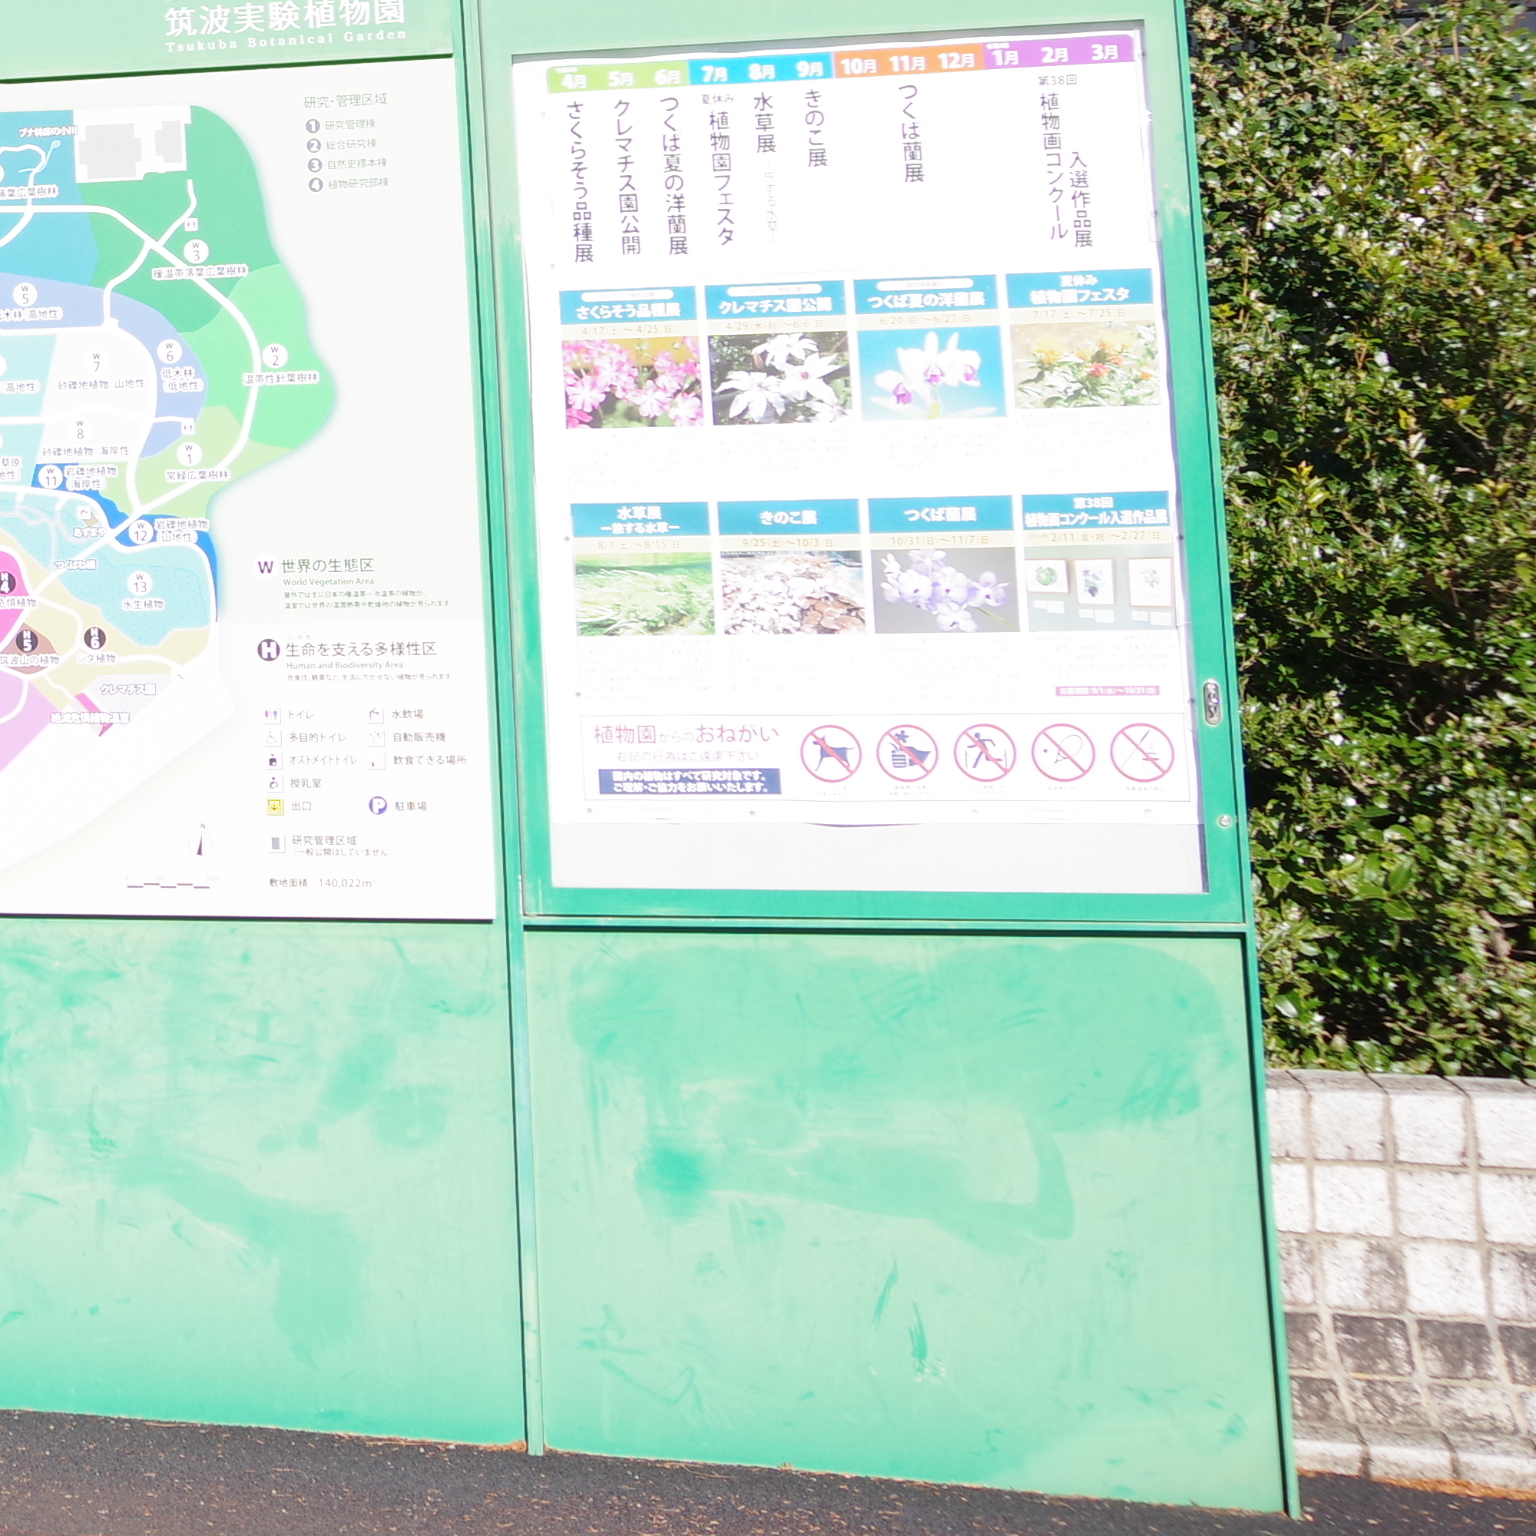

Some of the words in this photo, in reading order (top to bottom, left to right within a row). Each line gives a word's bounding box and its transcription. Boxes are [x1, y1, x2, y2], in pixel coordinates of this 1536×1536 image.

[166, 39, 237, 52] Tsukuba
[248, 33, 333, 48] Botanical
[344, 30, 407, 42] Garden
[994, 50, 1019, 65] 1月
[1042, 47, 1069, 62] 2月
[1092, 44, 1118, 60] 3月
[841, 59, 877, 74] 10月
[890, 56, 925, 72] 11月
[938, 52, 974, 68] 12月
[702, 66, 727, 82] 7月
[749, 64, 775, 79] 8月
[797, 61, 823, 77] 9月
[562, 74, 586, 89] 4月
[608, 71, 633, 86] 5月
[655, 69, 680, 85] 6月
[1038, 74, 1078, 86] 第38回
[304, 92, 388, 109] 研究・管理区域
[701, 94, 734, 104] 夏休み
[325, 119, 376, 131] 研究管理棟
[754, 92, 777, 153] 水草展
[804, 89, 828, 167] きのこ展
[898, 84, 925, 183] つくば蘭展
[326, 138, 377, 150] 総合研究棟
[327, 158, 387, 170] 自然史標本棟
[1040, 92, 1068, 240] 植物画コンクール
[567, 101, 594, 263] さくらそう品種展
[614, 99, 641, 255] クレマチス園公開
[660, 96, 689, 255] つくば夏の洋蘭展
[709, 110, 735, 246] 植物園フェスタ
[328, 177, 389, 190] 植物研究部棟
[1069, 151, 1093, 248] 入選作品展
[1061, 275, 1098, 287] 夏休み
[868, 292, 985, 309] つくば夏の洋蘭展
[1030, 288, 1129, 305] 植物園フェスタ
[576, 302, 680, 320] さくらそう品種展
[719, 297, 832, 314] クレマチス園公開
[162, 369, 193, 378] 低木林
[244, 372, 318, 385] 温帯性針葉樹林
[1074, 496, 1113, 509] 第38回
[618, 507, 661, 519] 水草展
[760, 510, 817, 525] きのこ展
[905, 507, 976, 522] つくば蘭展
[1026, 510, 1168, 527] 植物画コンクール入選作品展
[281, 558, 375, 573] 世界の生態区
[283, 578, 307, 586] World
[309, 577, 354, 588] Vegetation
[356, 577, 374, 585] Area
[285, 641, 438, 658] 生命を支える多様性区
[286, 662, 316, 670] Human
[318, 661, 334, 669] and
[335, 660, 383, 670] Biodiversity
[385, 660, 404, 668] Area
[288, 710, 314, 719] トイレ
[392, 709, 423, 719] 水飲場
[289, 732, 346, 743] 多目的トイレ
[393, 732, 446, 743] 自動販売機
[594, 724, 780, 744] 植物園からのおねがい
[289, 755, 358, 765] オストメイトトイレ
[394, 754, 467, 765] 飲食できる場所
[290, 778, 322, 789] 授乳室
[291, 801, 312, 811] 出口
[395, 801, 427, 811] 駐車場
[292, 835, 357, 846] 研究管理区域
